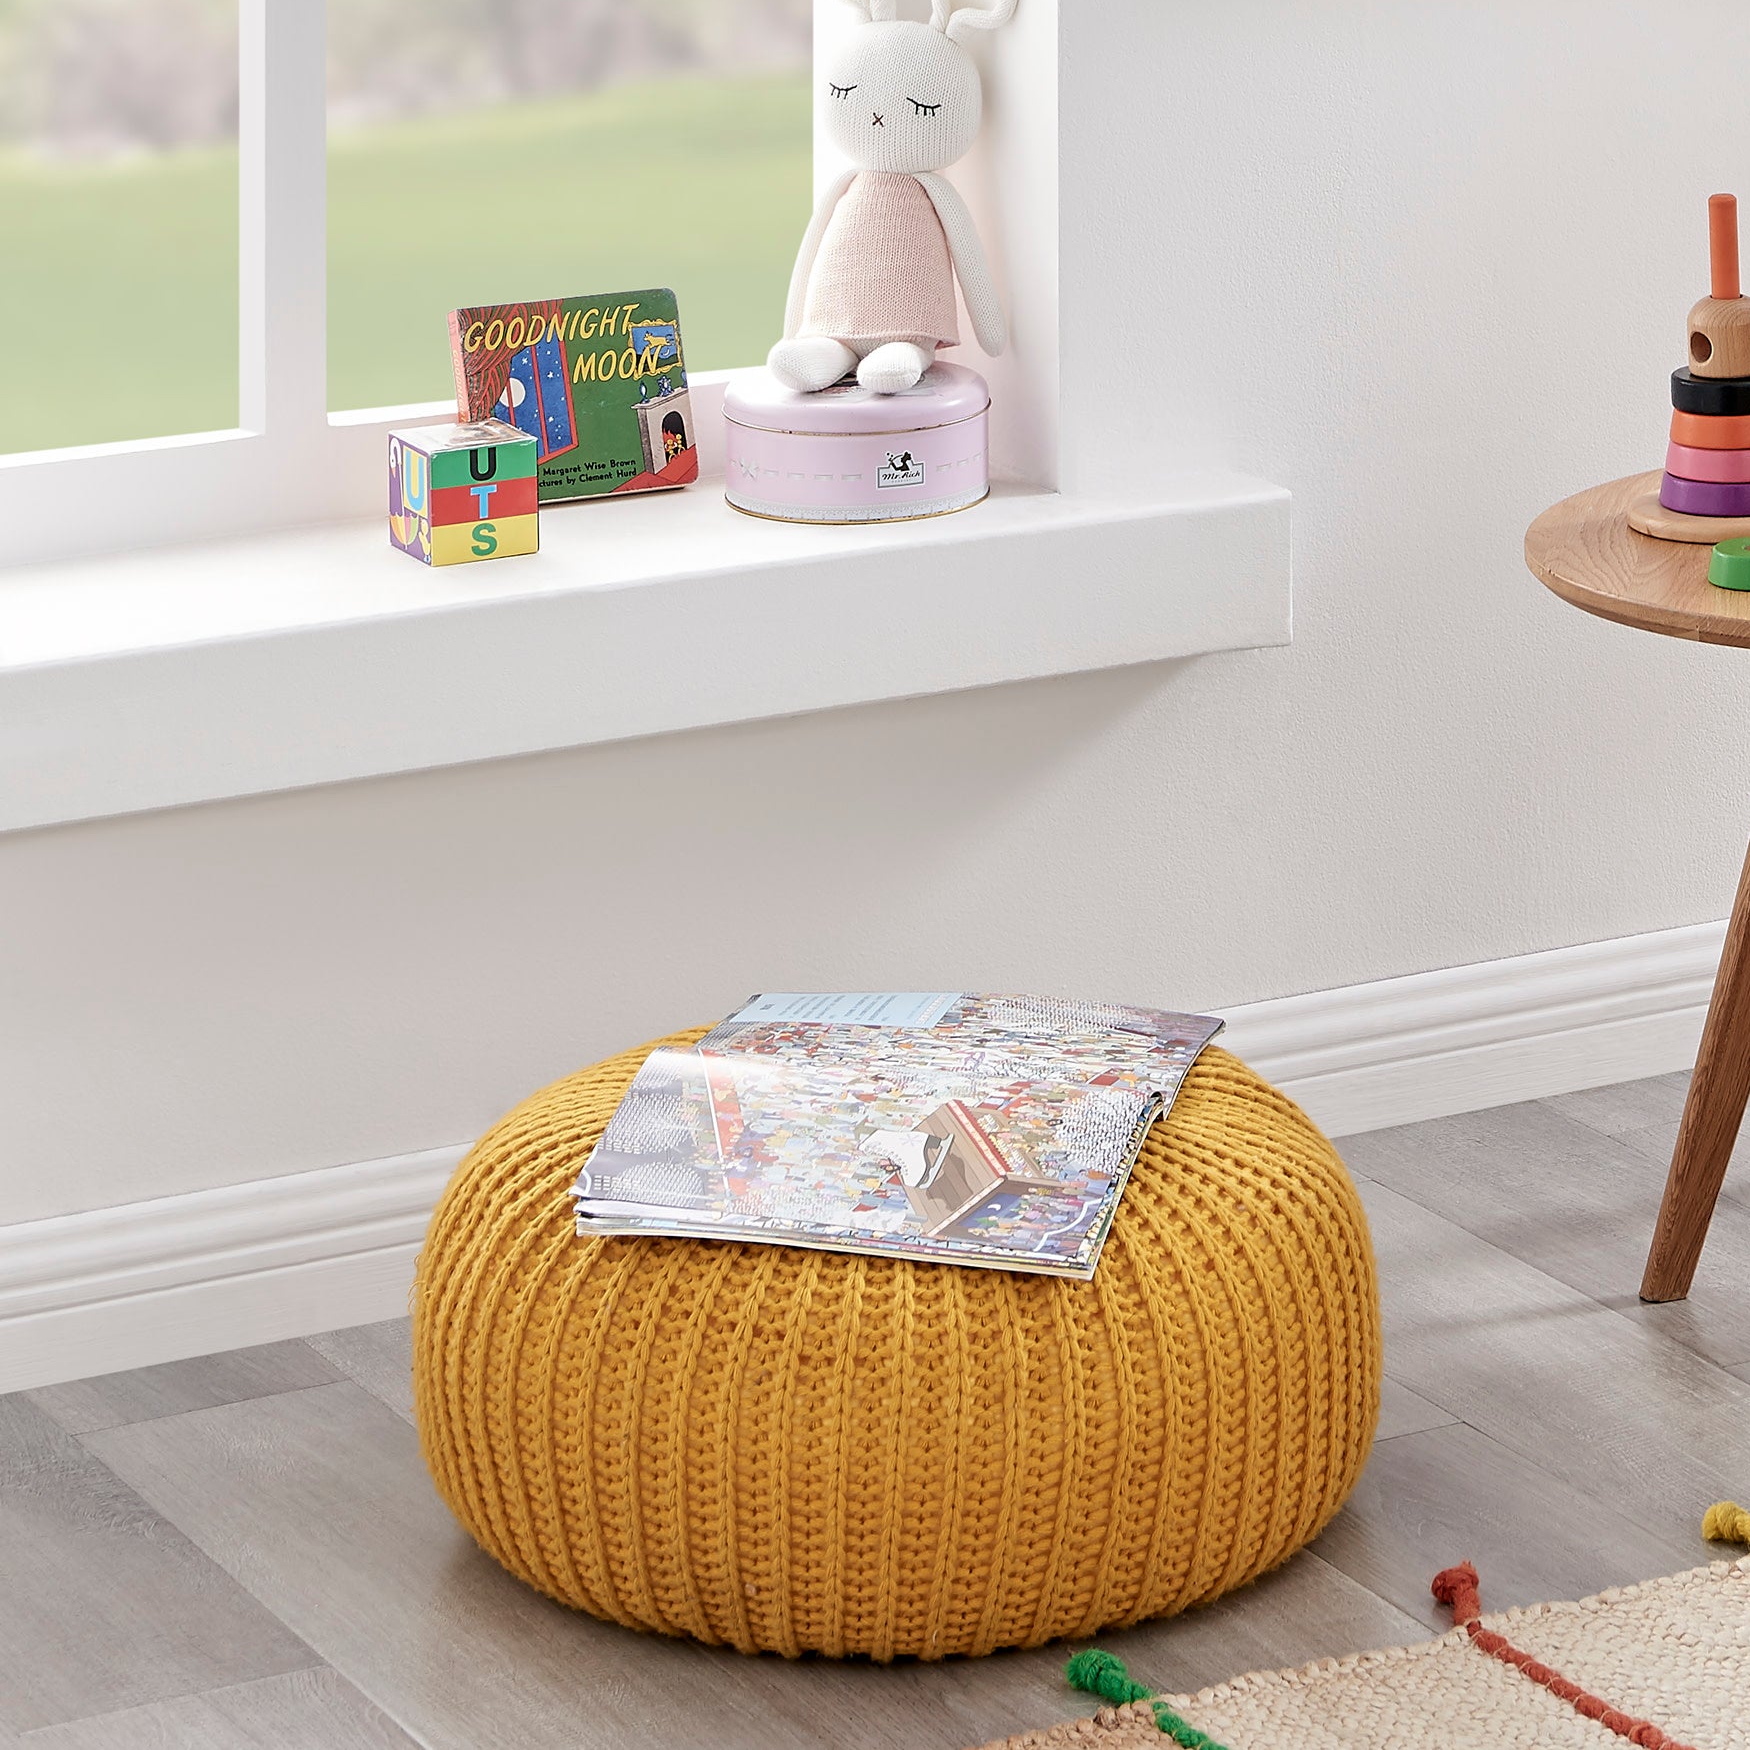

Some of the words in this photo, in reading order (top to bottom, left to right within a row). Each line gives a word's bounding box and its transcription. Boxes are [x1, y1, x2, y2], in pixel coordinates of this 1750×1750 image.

[463, 303, 640, 353] GOODNIGHT
[572, 344, 661, 384] MOON
[404, 450, 425, 512] U
[469, 447, 497, 482] U
[538, 478, 563, 487] ctures
[566, 476, 576, 485] by
[579, 471, 613, 482] Clement
[616, 467, 637, 478] Hurd
[543, 464, 581, 476] Margaret
[584, 461, 606, 470] Wise
[609, 459, 636, 468] Brown
[470, 484, 497, 520] T
[471, 523, 498, 556] S
